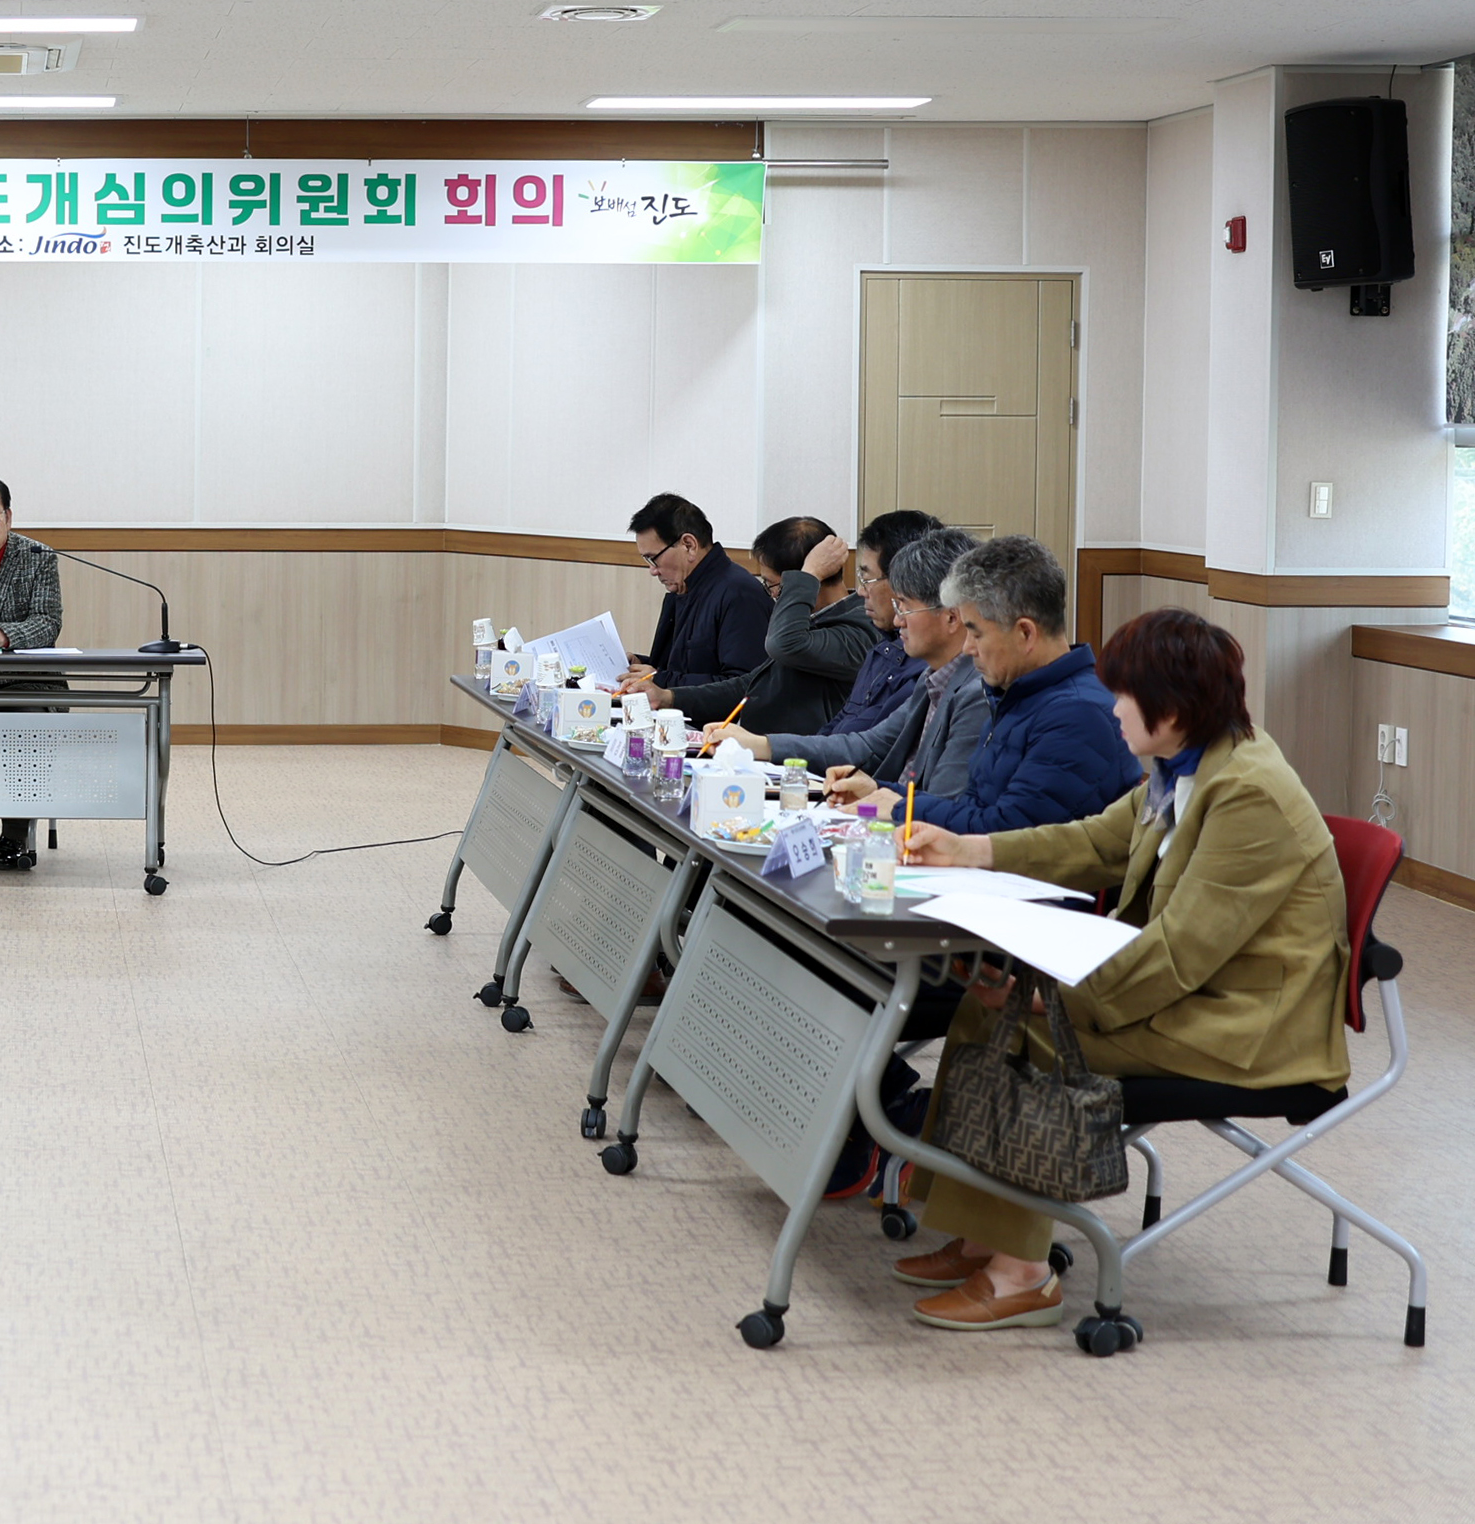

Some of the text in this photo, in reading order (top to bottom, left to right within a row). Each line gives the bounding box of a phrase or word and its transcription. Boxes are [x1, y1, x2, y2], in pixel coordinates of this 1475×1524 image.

[443, 173, 564, 227] 회의
[590, 193, 698, 225] 보배섬 진도
[28, 235, 98, 256] Jindo
[123, 234, 248, 257] 진도개축산과
[254, 234, 316, 257] 회의실
